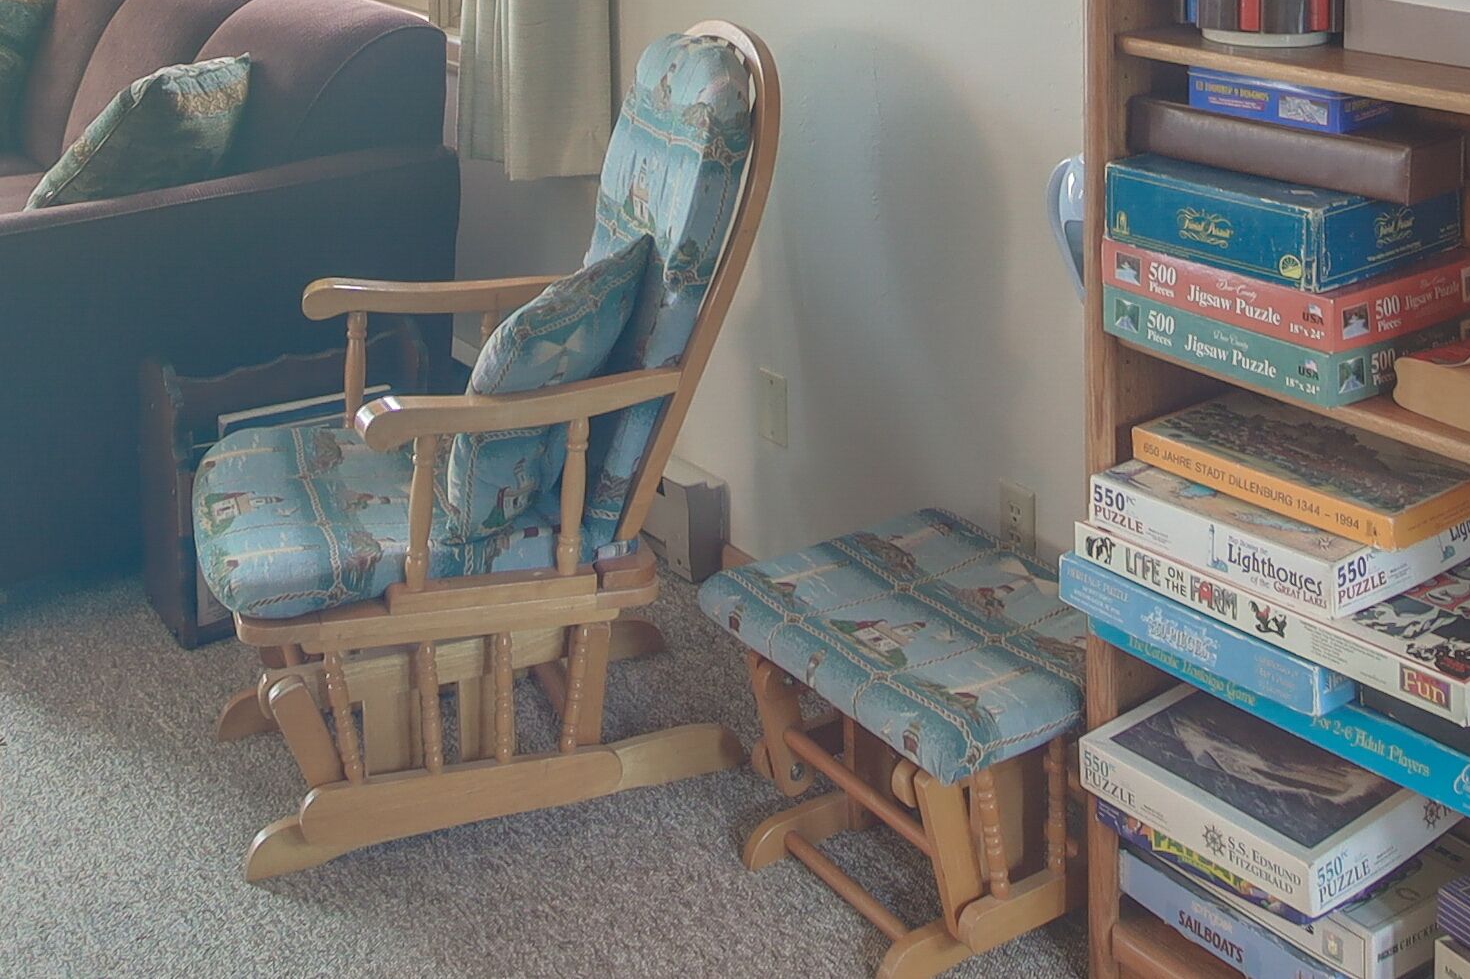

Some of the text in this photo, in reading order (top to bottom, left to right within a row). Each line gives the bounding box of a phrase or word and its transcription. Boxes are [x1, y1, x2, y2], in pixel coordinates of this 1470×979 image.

[1148, 261, 1177, 286] 500
[1149, 282, 1175, 298] Pieces
[1187, 284, 1281, 326] Jigsaw Puzzle
[1404, 291, 1434, 310] Jigsaw
[1147, 309, 1175, 335] 500
[1302, 312, 1325, 326] USA
[1375, 294, 1401, 320] 500
[1147, 328, 1173, 347] Pieces
[1377, 317, 1402, 333] Pieces
[1184, 334, 1278, 378] Jigsaw Puzzle
[1371, 347, 1396, 374] 500
[1298, 365, 1320, 381] USA
[1373, 372, 1394, 386] Piece
[1094, 483, 1125, 512] 550
[1143, 444, 1160, 458] 650
[1161, 448, 1193, 469] JAHRE
[1194, 461, 1228, 482] STADT
[1296, 498, 1321, 517] 1344
[1334, 511, 1360, 530] 1994
[1094, 503, 1145, 534] PUZZLE
[1126, 547, 1238, 620] LIFE ON THE FARM
[1227, 542, 1323, 597] Lighthouses
[1337, 555, 1367, 588] 550
[1258, 577, 1271, 589] the
[1303, 589, 1328, 609] LAKES
[1338, 570, 1388, 605] PUZZLE
[1226, 682, 1257, 707] Game
[1403, 669, 1446, 705] Fun
[1084, 750, 1109, 778] 550
[1332, 719, 1353, 741] 2-6
[1350, 726, 1386, 757] Adult
[1387, 744, 1431, 779] Players
[1085, 768, 1136, 807] PUZZLE
[1227, 835, 1250, 858] S.S.
[1252, 849, 1303, 887] EDMUND
[1229, 853, 1294, 896] FITZGERALD
[1317, 855, 1342, 887] 550
[1318, 858, 1371, 904] PUZZLE
[1179, 910, 1244, 963] SAILBOATS
